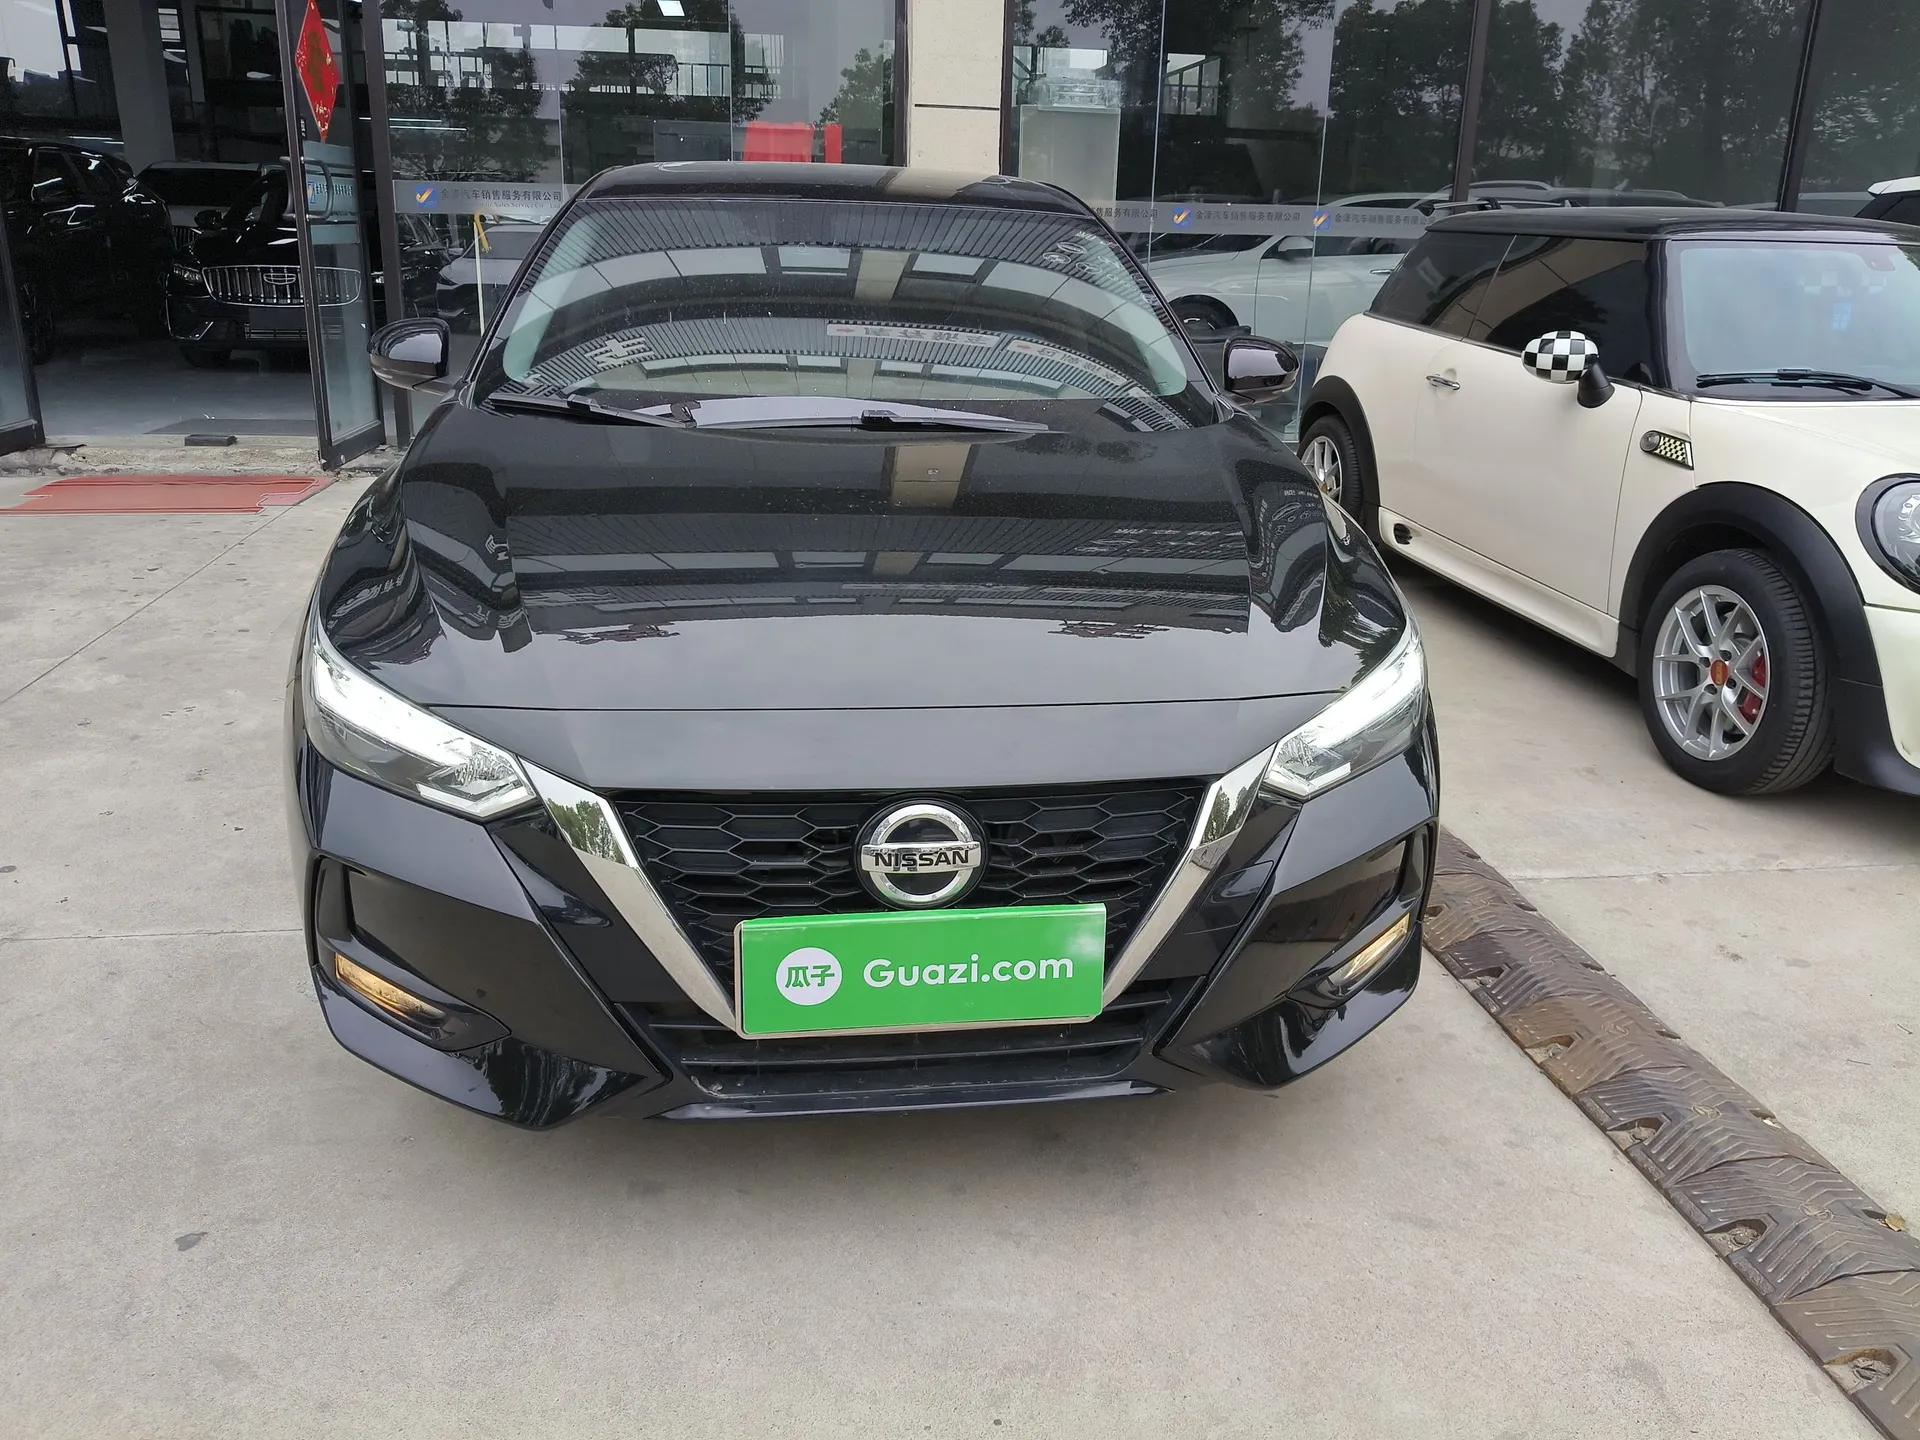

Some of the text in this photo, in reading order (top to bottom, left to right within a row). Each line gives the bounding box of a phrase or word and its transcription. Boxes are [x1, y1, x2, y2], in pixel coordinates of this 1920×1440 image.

[874, 849, 970, 867] NISSAN
[785, 964, 835, 989] 瓜子
[863, 953, 1074, 988] Guazi.com
